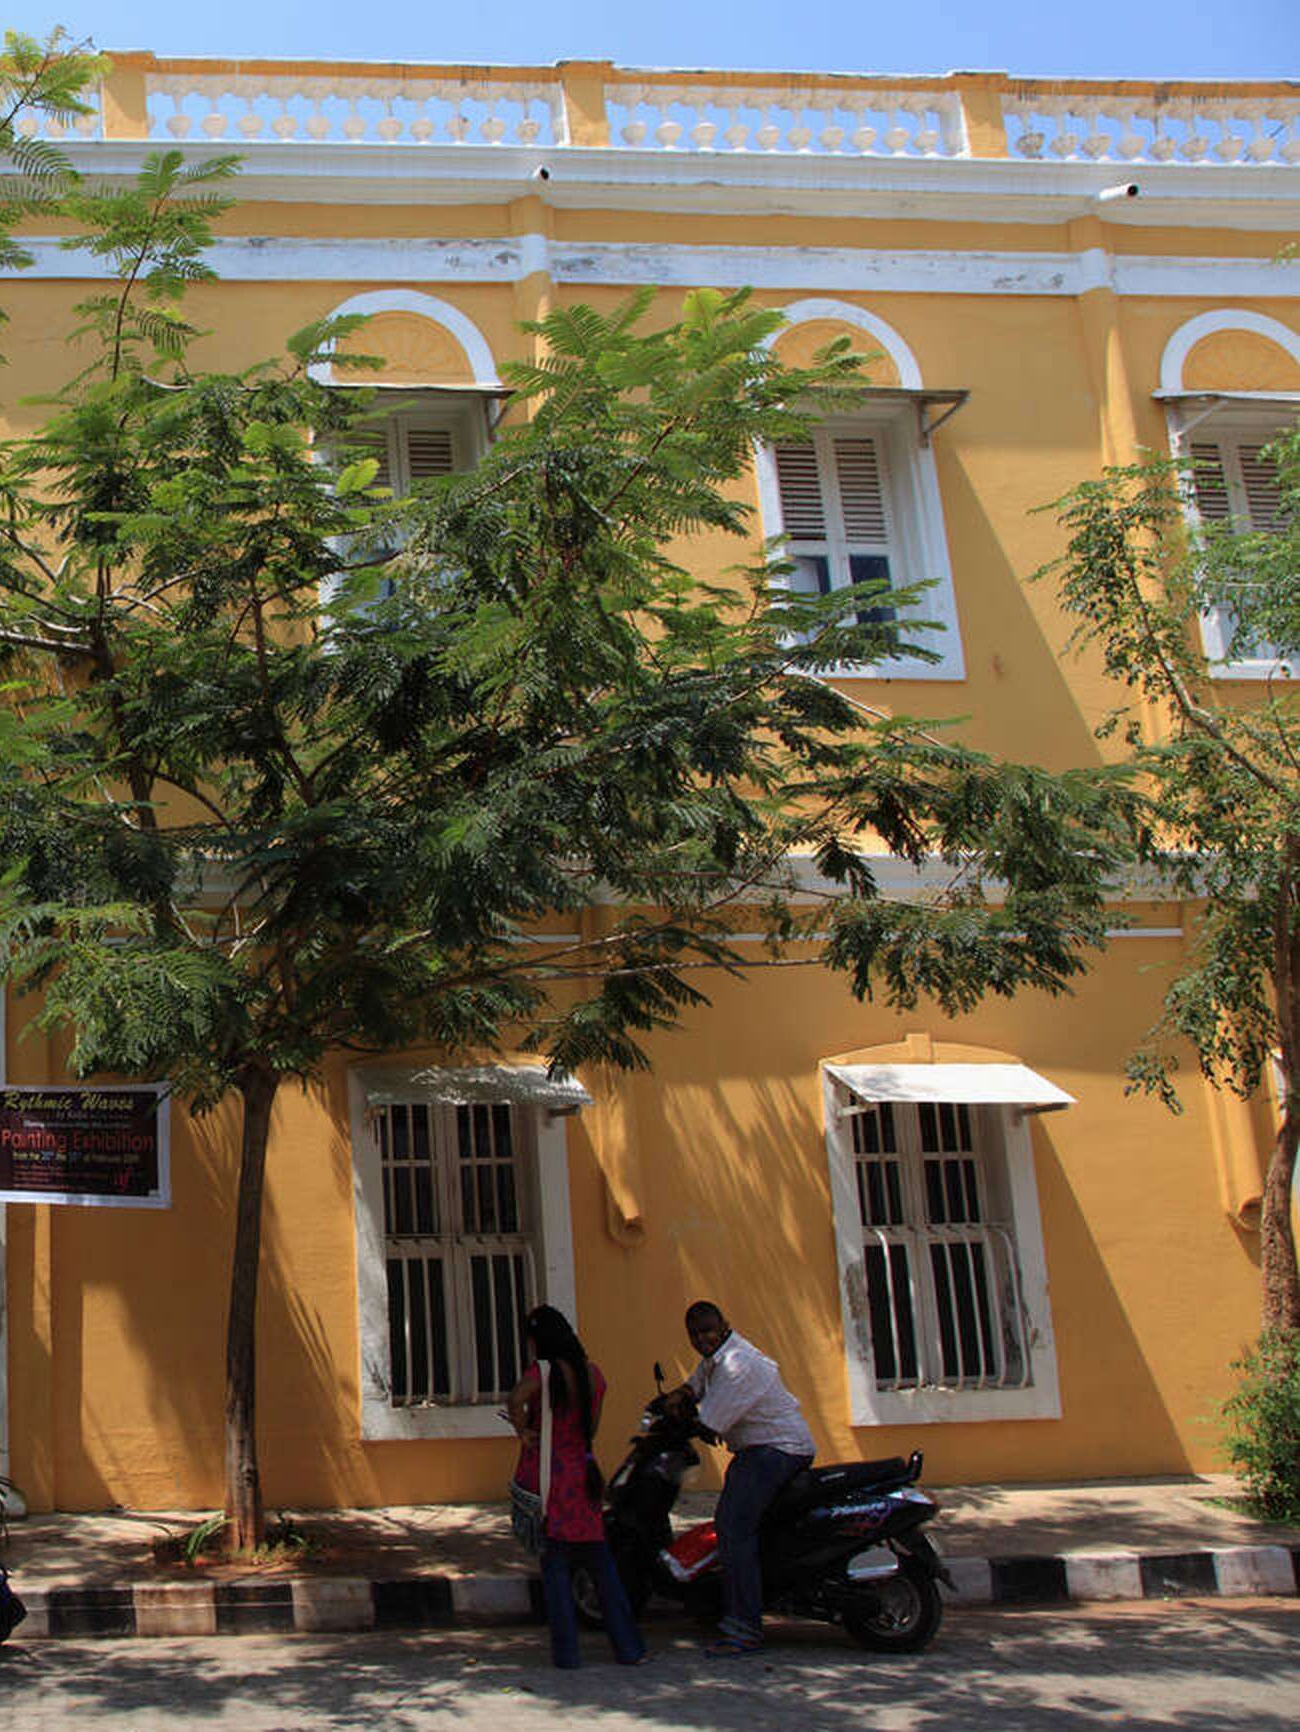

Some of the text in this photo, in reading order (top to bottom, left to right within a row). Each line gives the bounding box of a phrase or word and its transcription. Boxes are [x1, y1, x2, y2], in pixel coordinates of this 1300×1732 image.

[79, 1092, 134, 1110] Waves
[1, 1129, 154, 1153] Painting Exhibition
